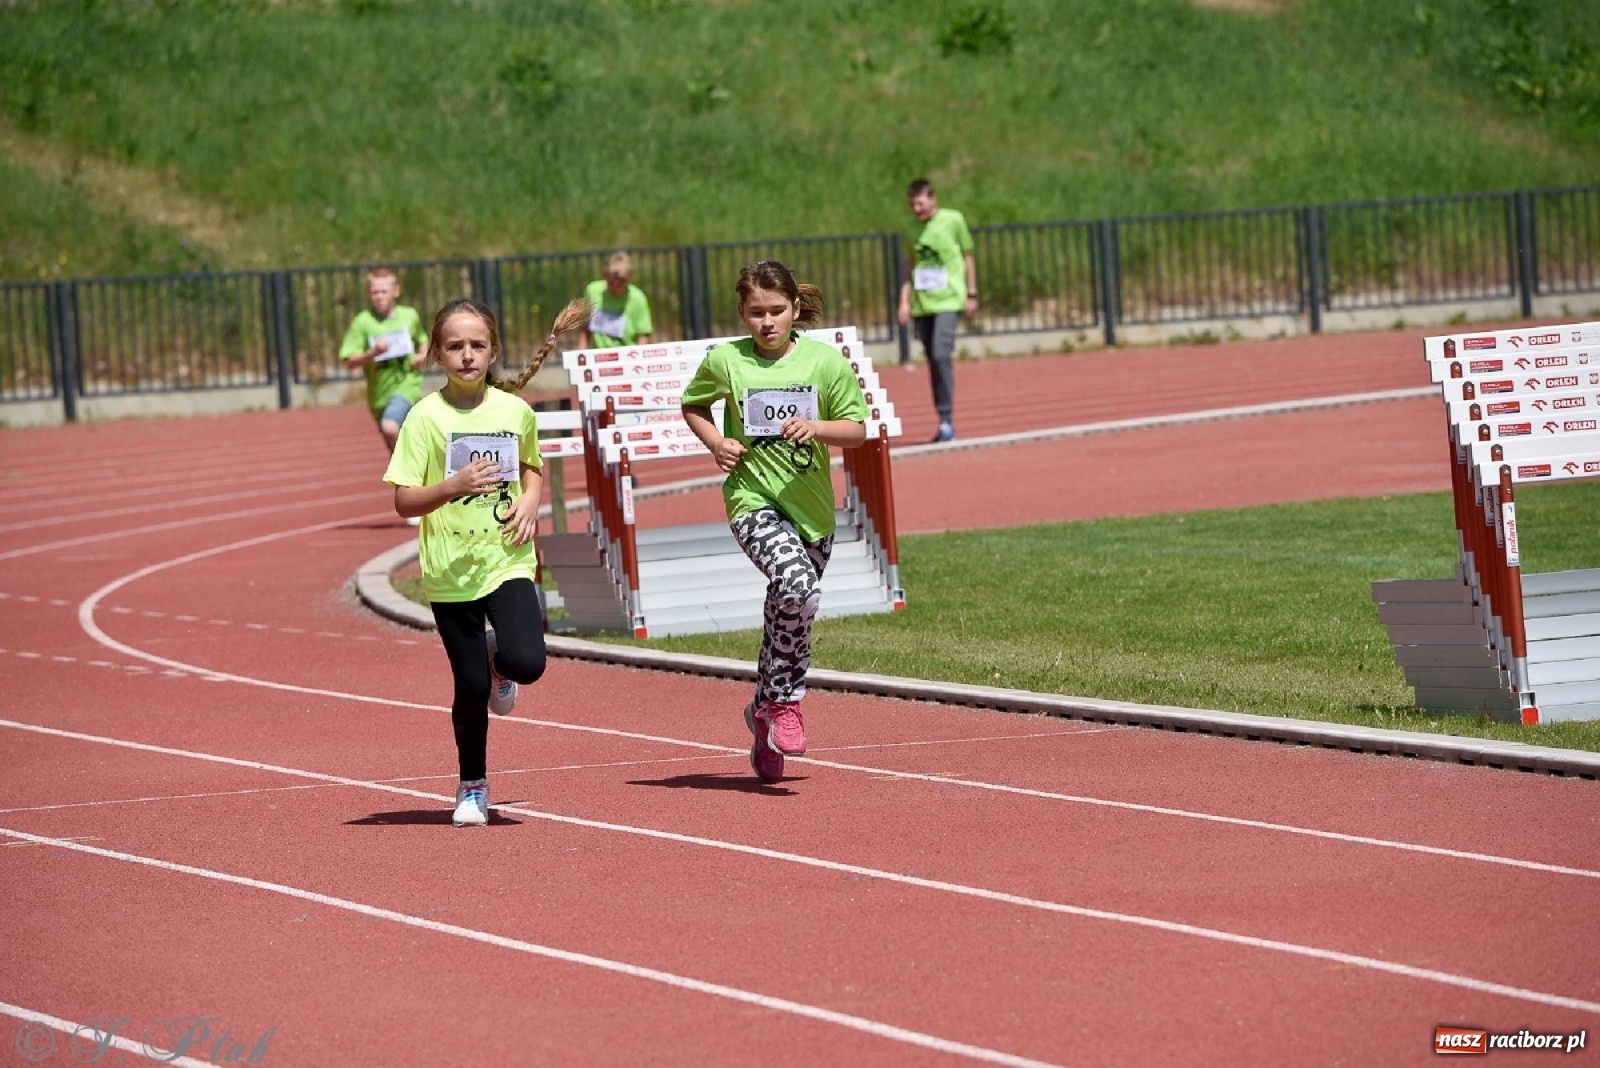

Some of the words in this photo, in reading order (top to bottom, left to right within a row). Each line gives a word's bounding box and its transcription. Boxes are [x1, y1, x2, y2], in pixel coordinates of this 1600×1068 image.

[1529, 334, 1559, 345] ORLEN
[1536, 356, 1567, 368] ORLEN
[1546, 376, 1577, 388] ORLEN
[1553, 397, 1584, 409] ORLEN
[764, 404, 797, 420] 069
[1565, 420, 1595, 431] ORLEN
[1506, 519, 1518, 554] polanik
